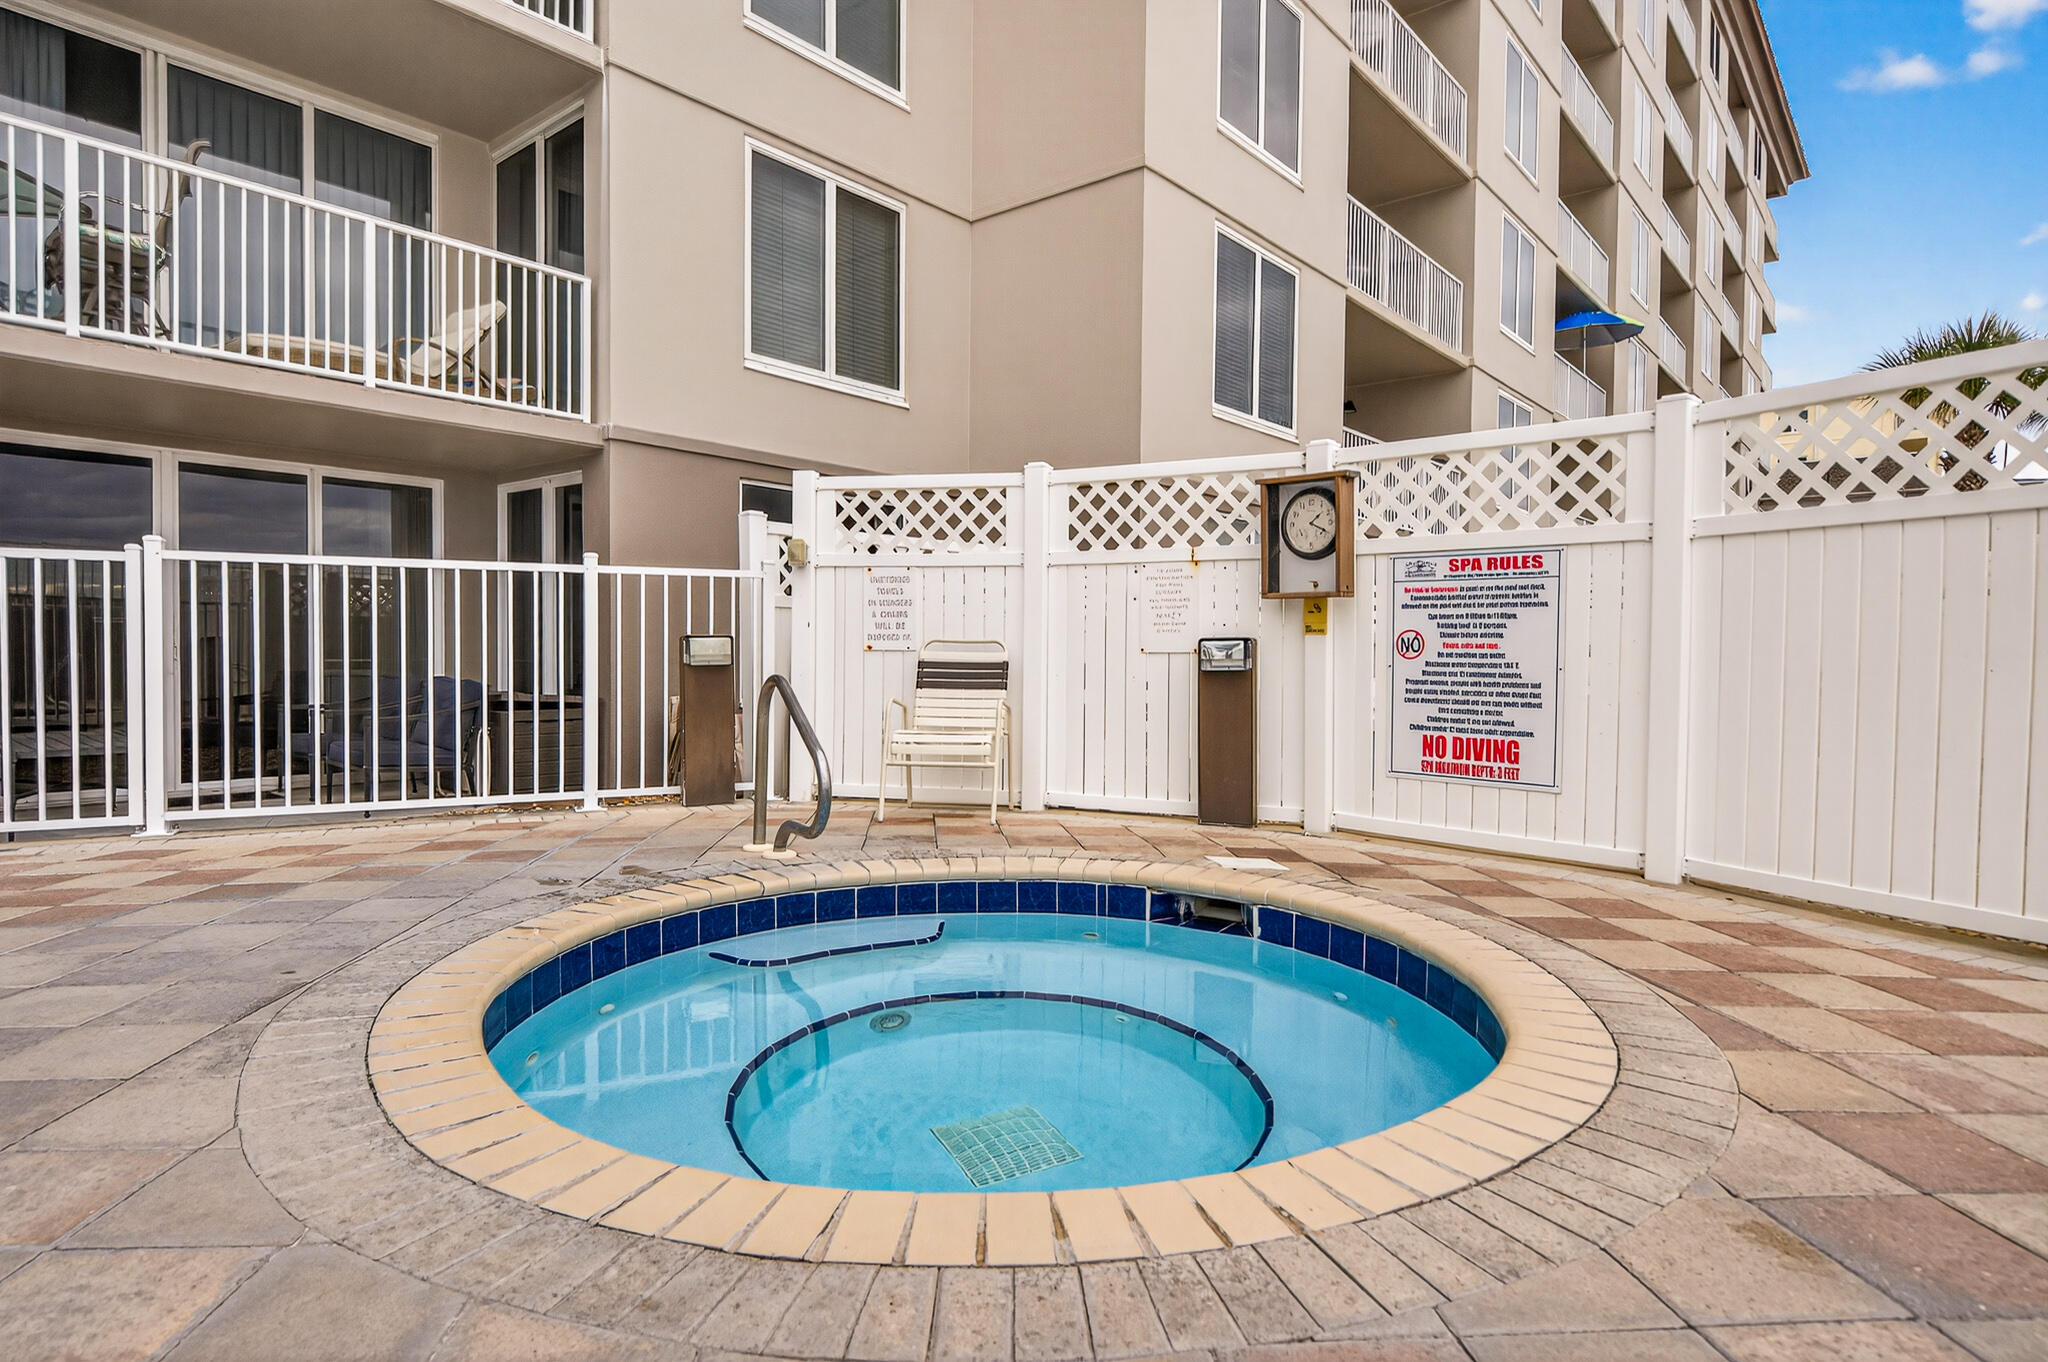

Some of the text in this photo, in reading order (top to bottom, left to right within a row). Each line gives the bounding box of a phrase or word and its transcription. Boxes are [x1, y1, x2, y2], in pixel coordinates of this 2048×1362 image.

[1448, 558, 1483, 572] SPA
[1487, 554, 1544, 571] RULES
[1400, 634, 1421, 653] NO
[1422, 734, 1520, 764] NO DIVING
